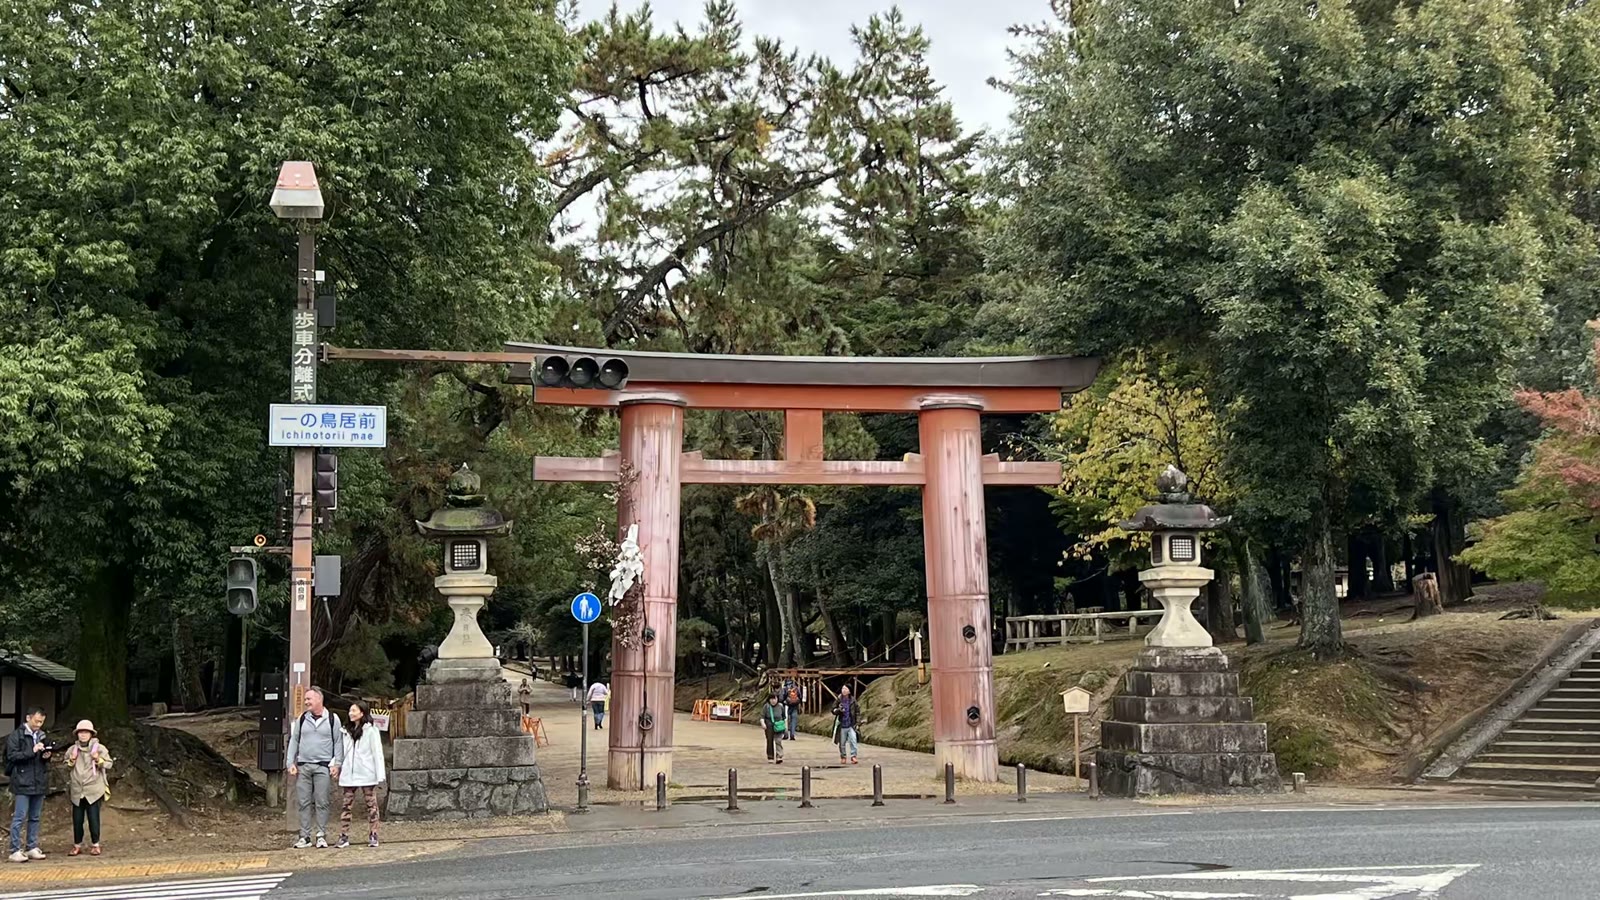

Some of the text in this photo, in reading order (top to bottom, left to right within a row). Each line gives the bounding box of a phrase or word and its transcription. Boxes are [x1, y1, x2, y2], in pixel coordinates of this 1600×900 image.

[294, 311, 315, 401] 歩車分離式
[280, 412, 376, 429] 一の鳥居前
[351, 432, 374, 441] mae
